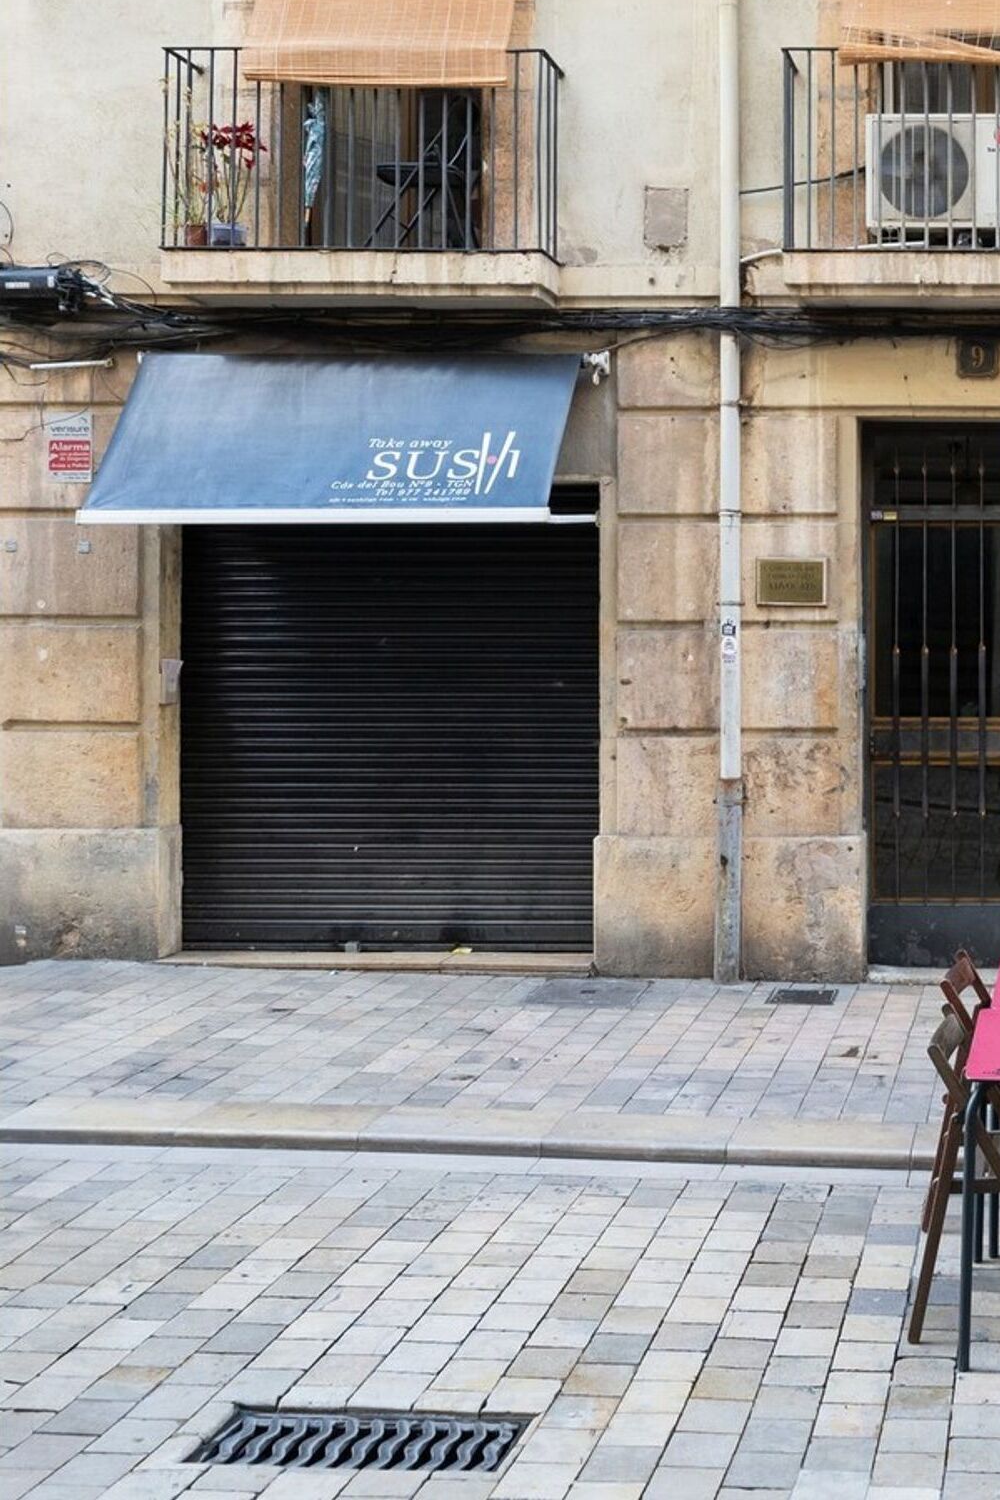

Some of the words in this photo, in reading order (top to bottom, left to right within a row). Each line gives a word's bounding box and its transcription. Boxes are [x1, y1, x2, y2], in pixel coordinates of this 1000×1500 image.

[971, 345, 984, 368] 9
[51, 442, 90, 451] Alarma
[368, 437, 404, 448] Take
[409, 439, 453, 450] away
[447, 479, 474, 487] TGN
[375, 488, 393, 496] Tel
